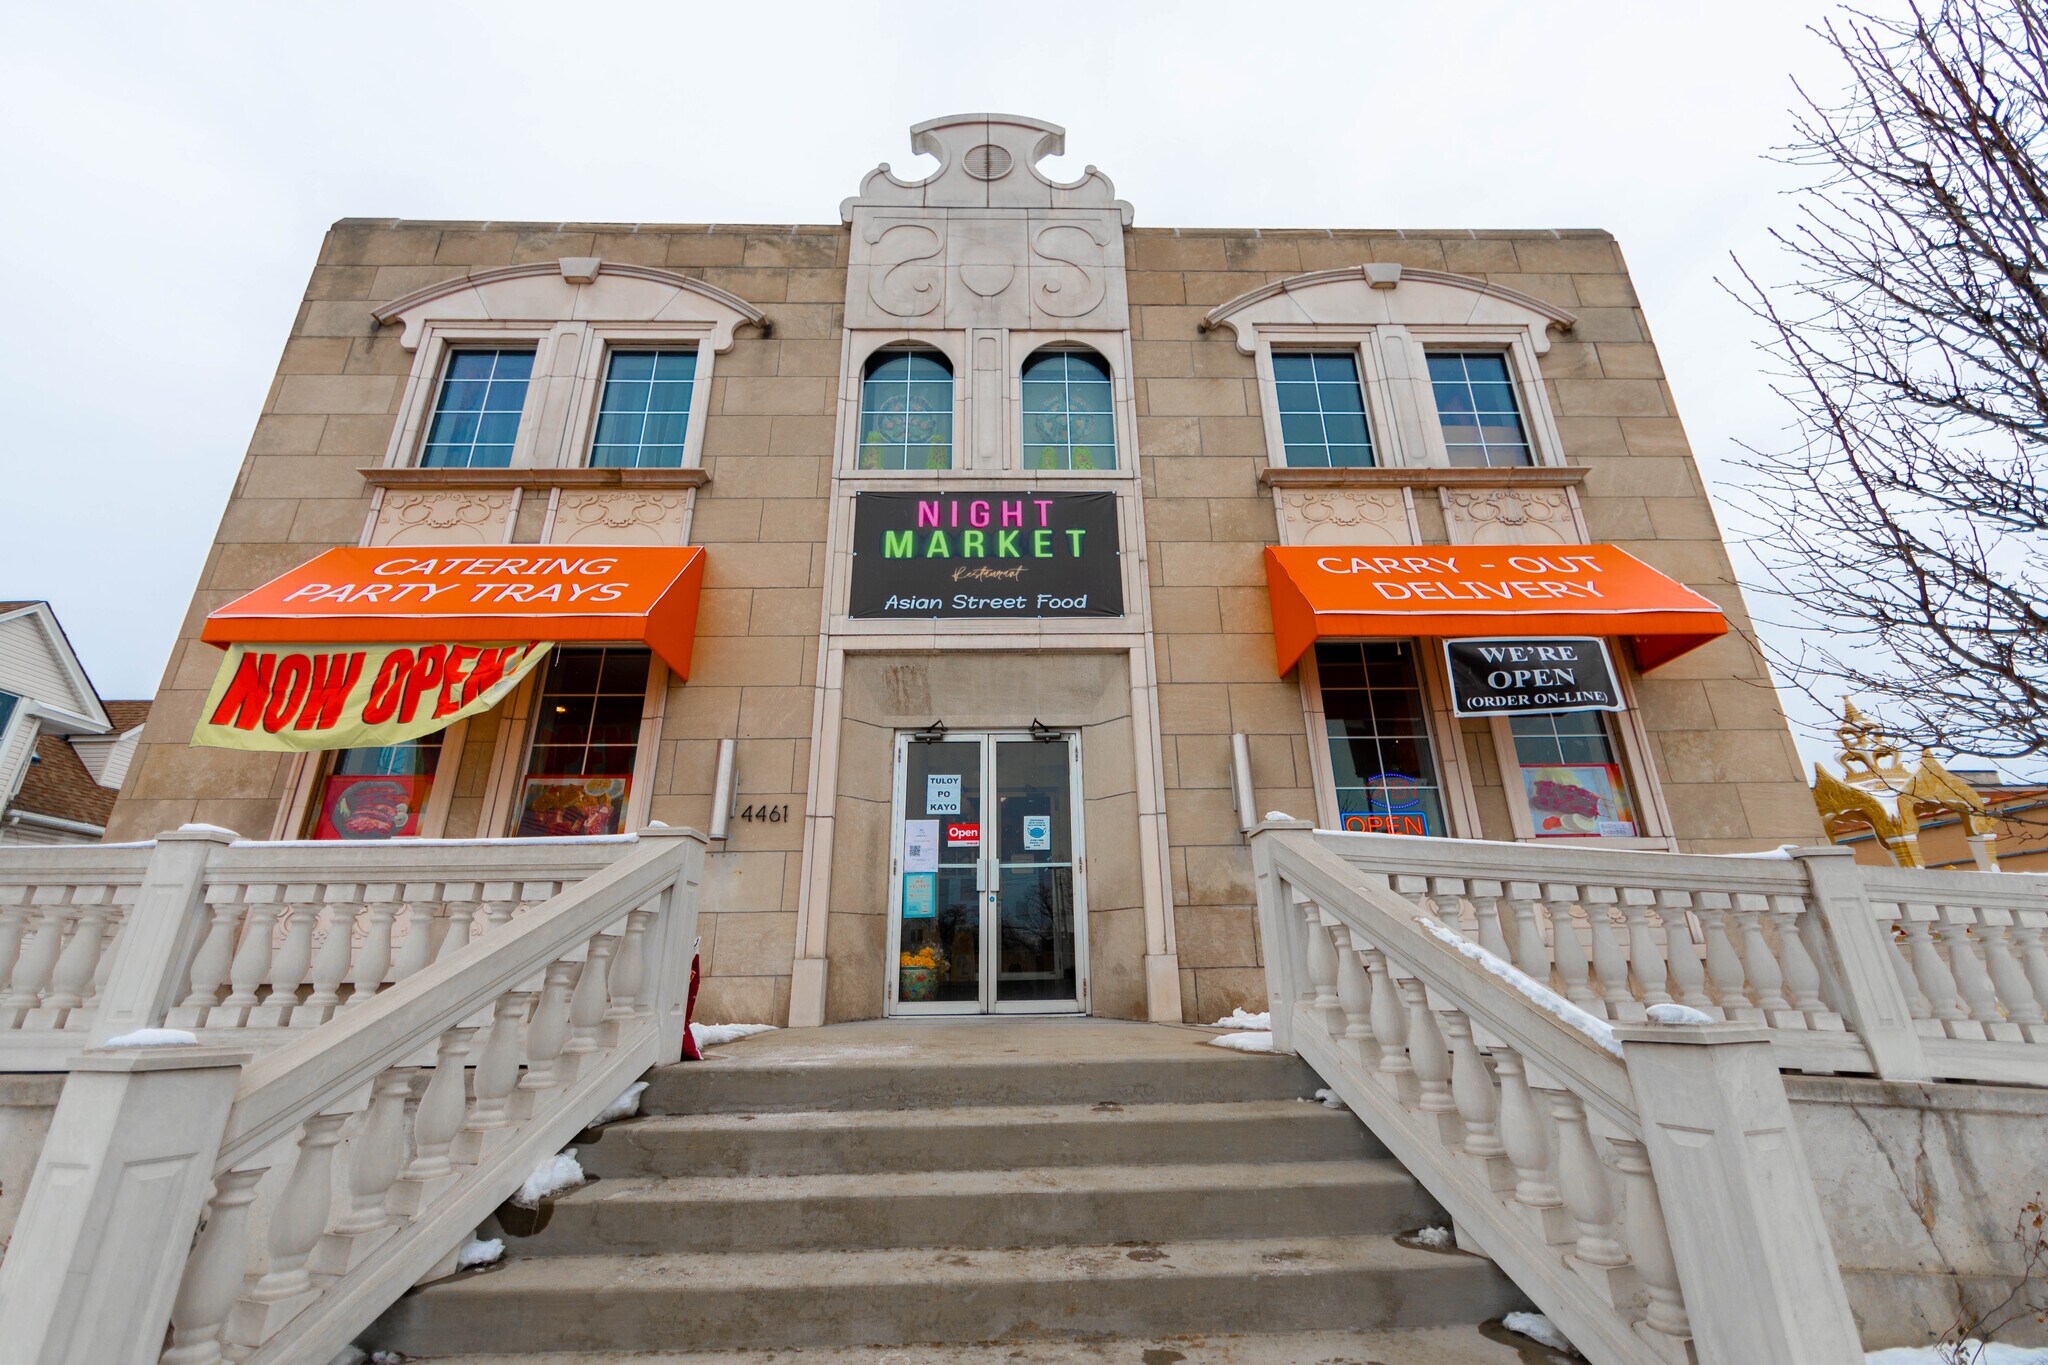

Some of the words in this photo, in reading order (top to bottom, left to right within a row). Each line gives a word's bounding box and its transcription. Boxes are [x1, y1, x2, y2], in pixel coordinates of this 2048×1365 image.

[917, 500, 1054, 528] NIGHT
[884, 529, 1087, 559] MARKET
[372, 558, 619, 576] CATERING
[951, 564, 1029, 582] Restaurant
[1316, 556, 1460, 574] CARRY
[1507, 555, 1604, 574] OUT
[282, 583, 461, 603] PARTY
[469, 583, 630, 603] TRAYS
[1372, 580, 1605, 600] DELIVERY
[884, 594, 943, 610] Asian
[951, 594, 1027, 610] Street
[1036, 593, 1088, 609] Food
[1477, 646, 1579, 664] WE'RE
[1487, 667, 1576, 690] OPEN
[209, 651, 367, 733] NOW
[1466, 694, 1532, 710] (ORDER
[1534, 691, 1609, 705] ON-LINE)
[930, 777, 959, 785] TULOY
[937, 790, 951, 798] PO
[741, 804, 789, 823] 4461
[930, 803, 957, 811] KAYO
[949, 827, 978, 840] Open
[1345, 815, 1424, 836] OPEN
